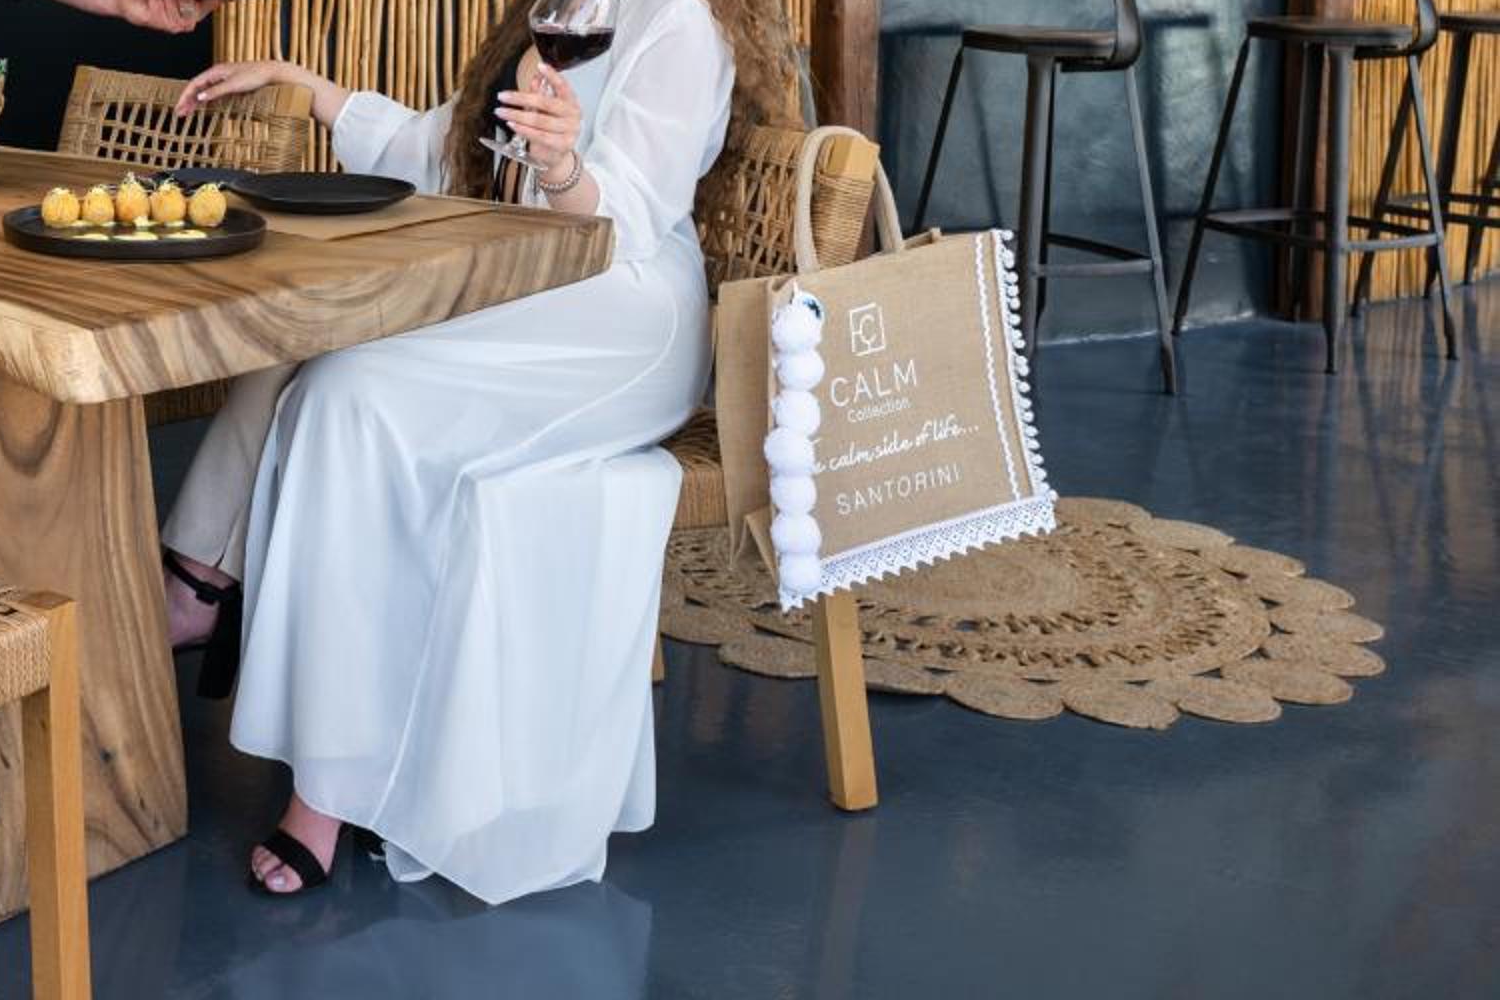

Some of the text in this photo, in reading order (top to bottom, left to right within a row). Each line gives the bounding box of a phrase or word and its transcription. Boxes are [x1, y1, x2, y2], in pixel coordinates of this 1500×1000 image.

[829, 358, 918, 408] CALM
[829, 441, 873, 471] calm
[874, 429, 913, 459] side
[835, 463, 962, 516] SANTORINI
